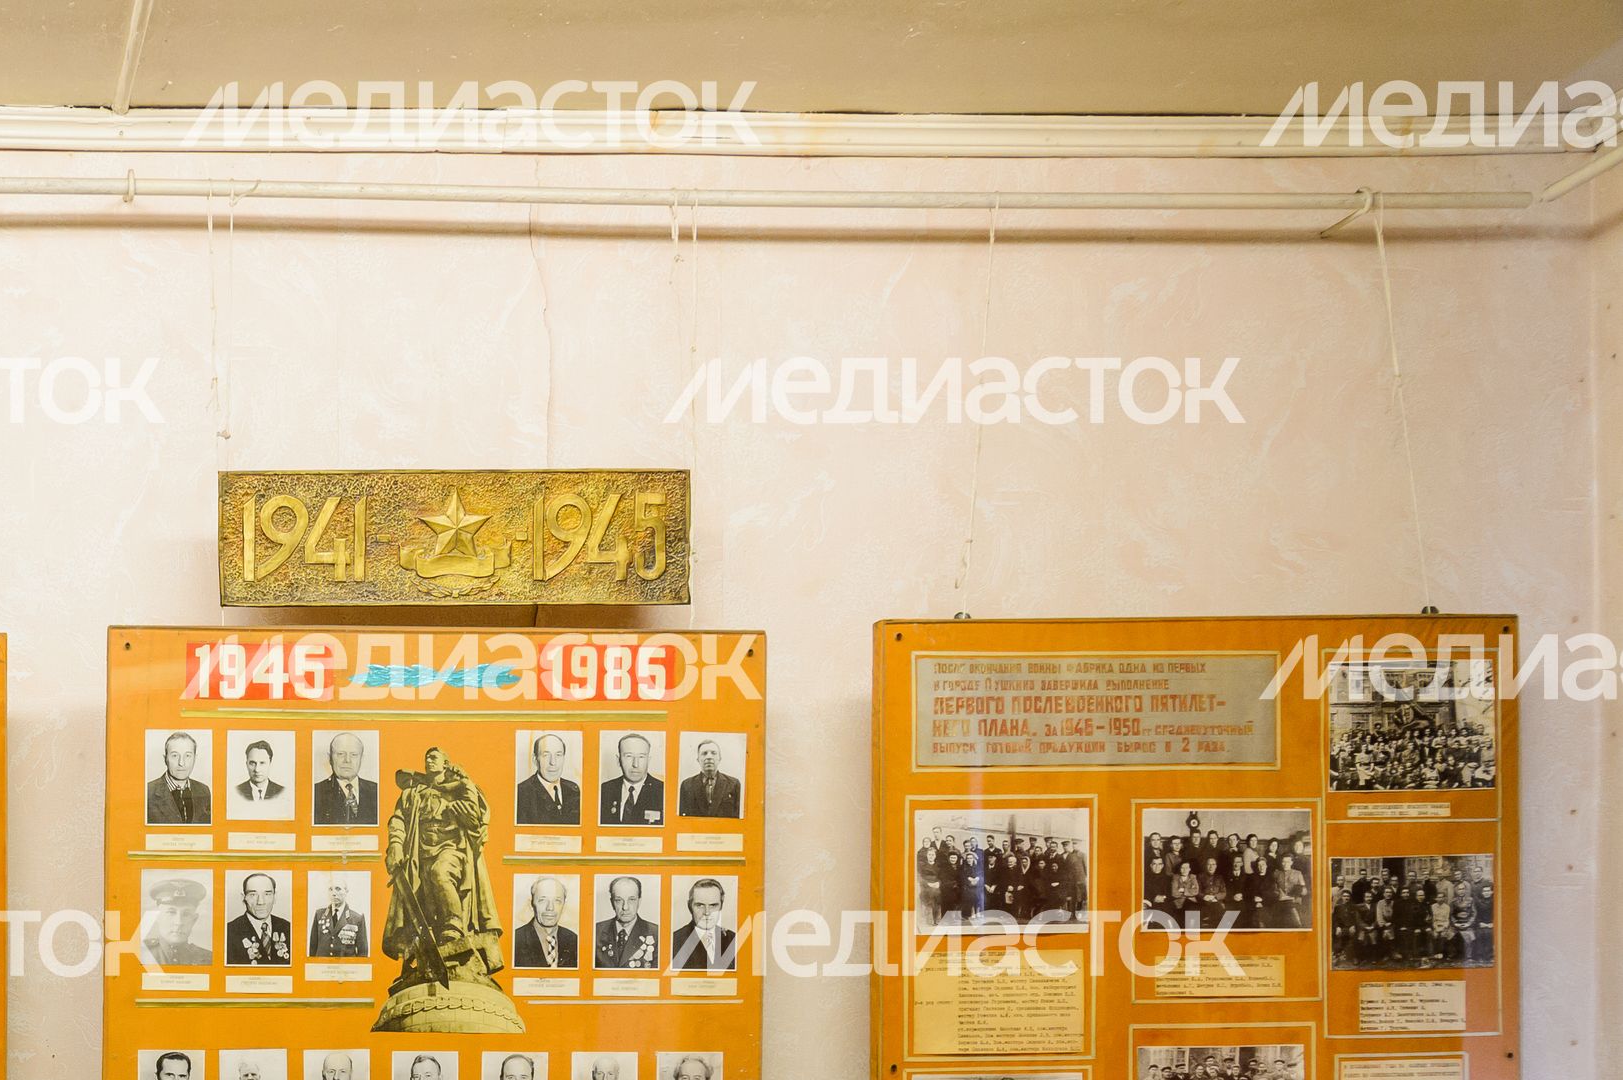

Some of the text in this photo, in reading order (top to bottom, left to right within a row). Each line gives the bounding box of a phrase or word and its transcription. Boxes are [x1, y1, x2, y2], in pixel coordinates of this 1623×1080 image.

[534, 492, 668, 583] 1945
[1119, 662, 1147, 673] ОДНА
[1168, 662, 1207, 673] ПЕРВЫХ
[934, 694, 1226, 715] ПЕРВОГО ПОСЛЕВОЕННОГО ПЯТИЛЕТ-
[932, 742, 977, 754] ВЫПУСК
[1039, 742, 1105, 753] ПРОДУКЦИИ
[1181, 736, 1190, 752] 2
